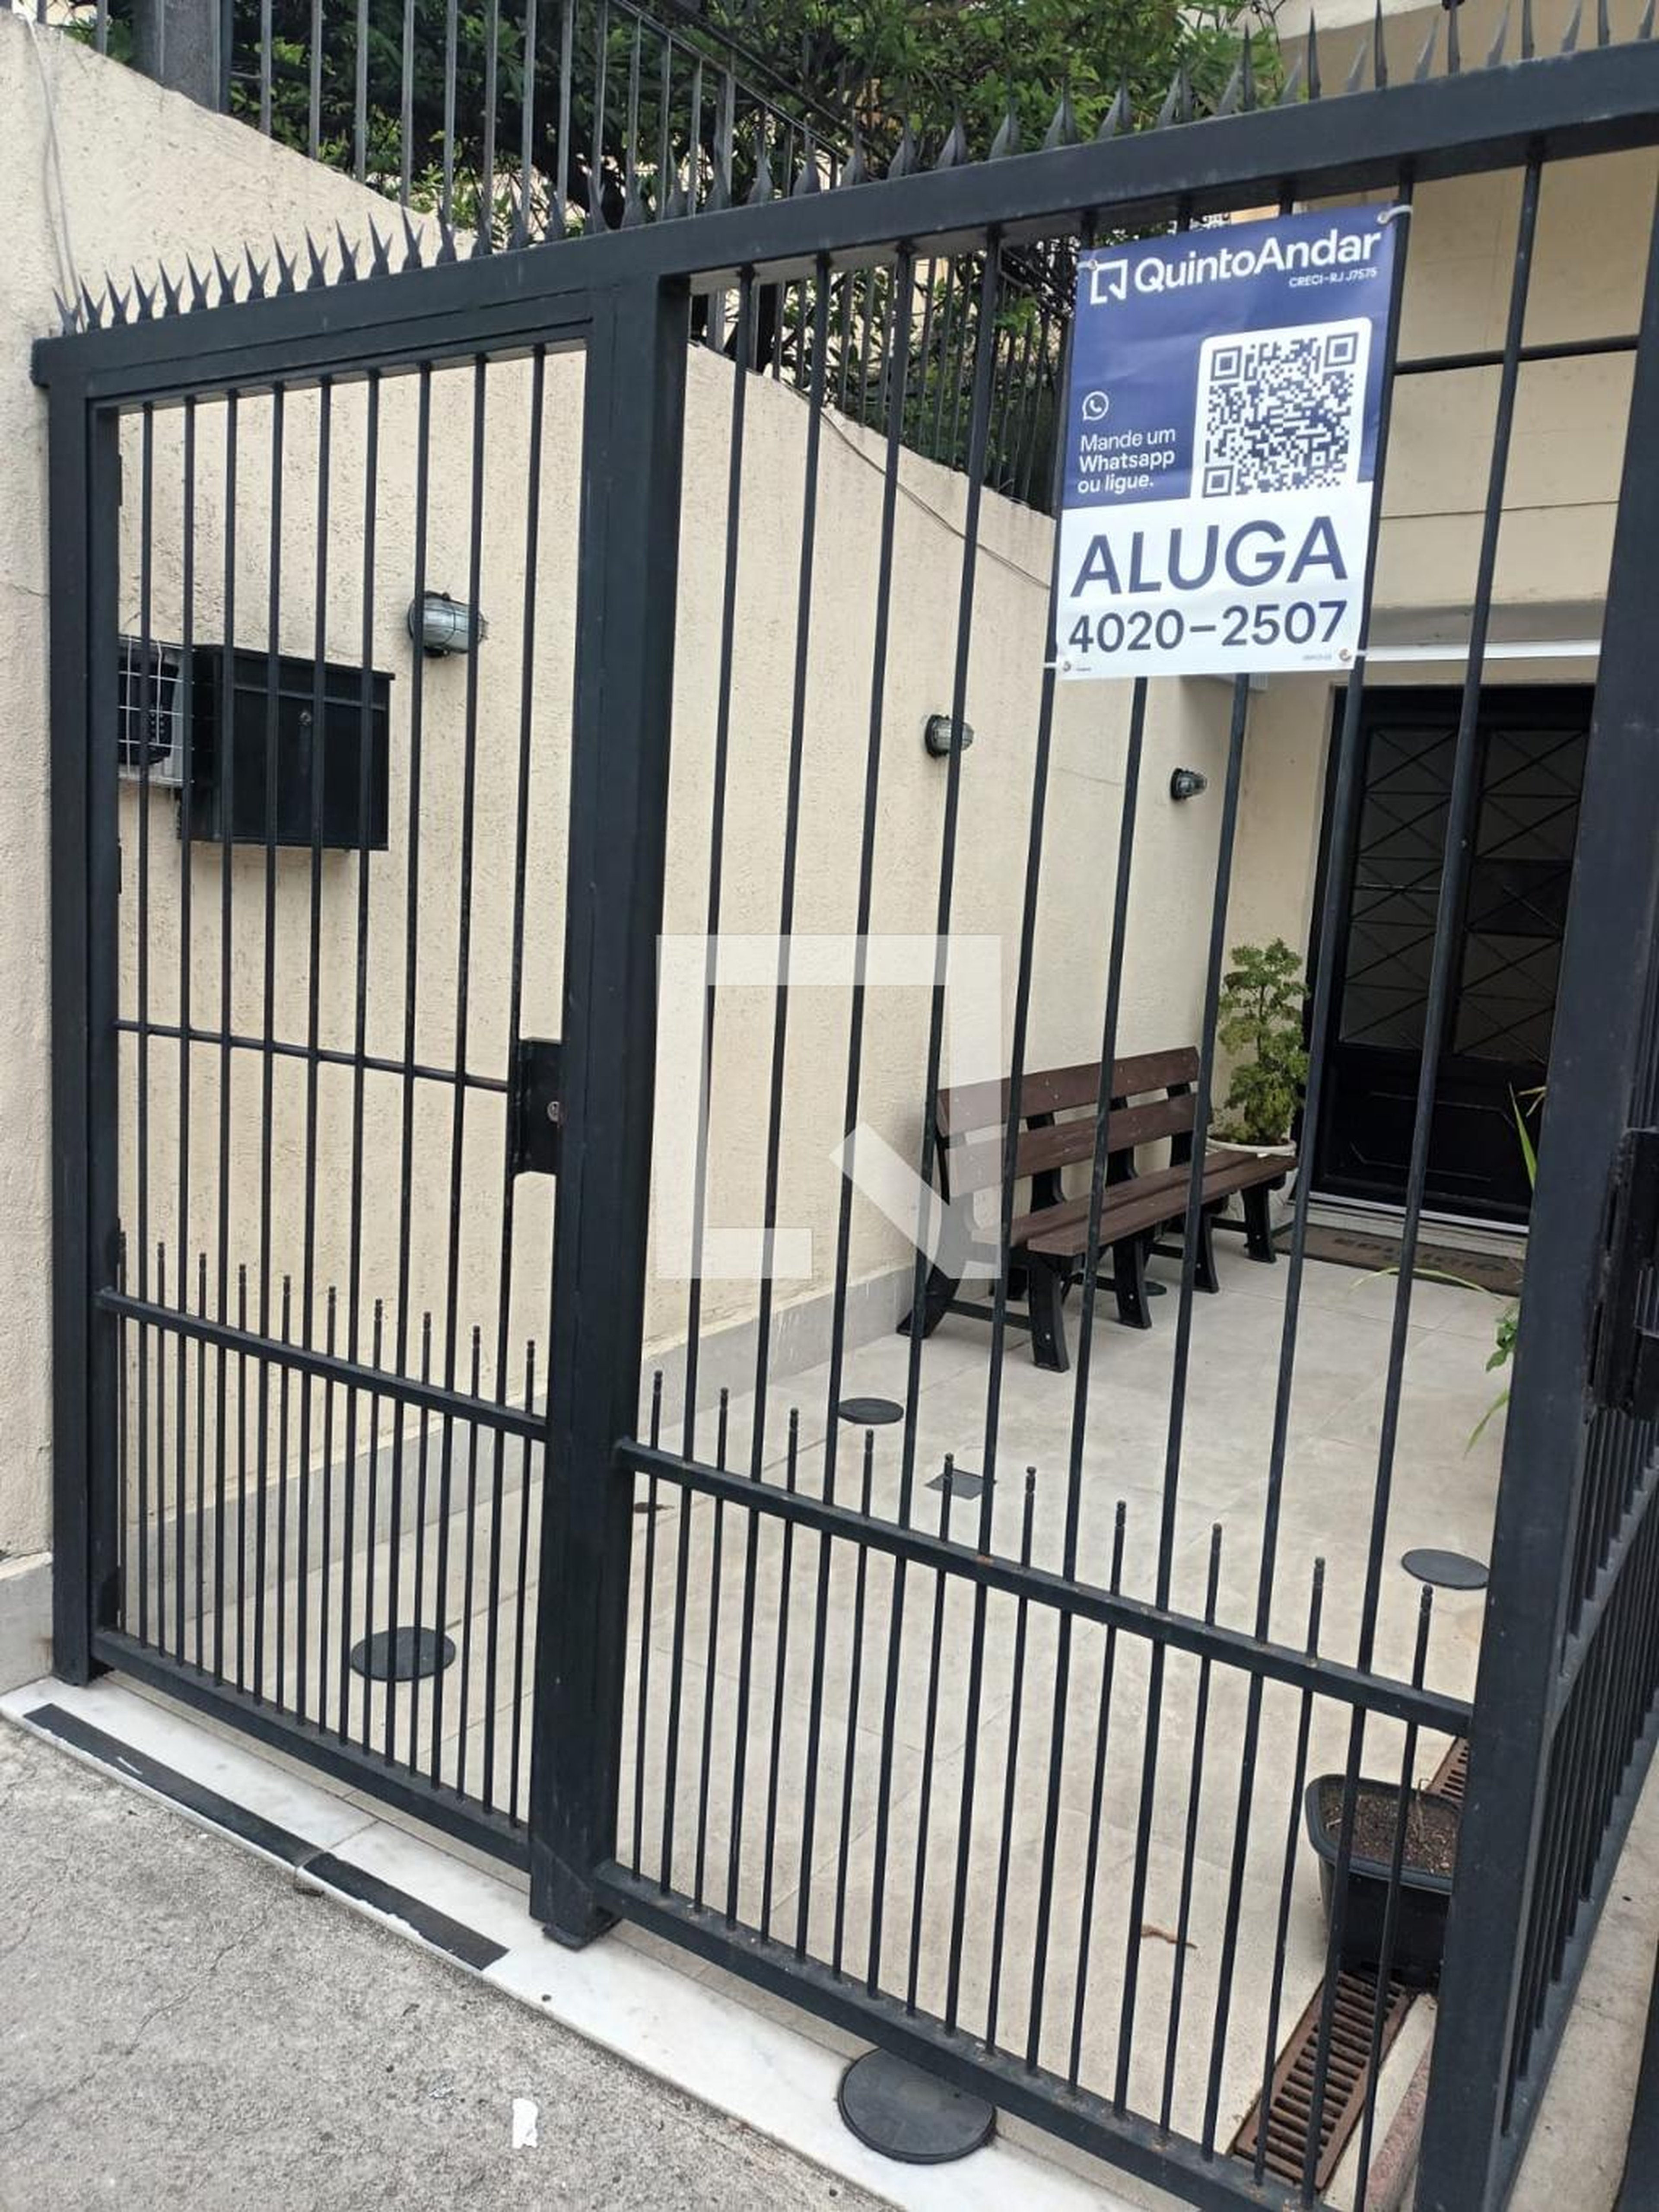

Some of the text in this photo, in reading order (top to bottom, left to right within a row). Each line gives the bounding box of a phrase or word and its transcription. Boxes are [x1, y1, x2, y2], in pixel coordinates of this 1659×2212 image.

[1135, 229, 1381, 293] QuintoAndar
[1289, 272, 1344, 287] CRECI-RJ
[1081, 428, 1176, 452] Mande um
[1079, 450, 1175, 473] Whatsapp
[1077, 473, 1154, 494] ou ligue.
[1070, 516, 1348, 597] ALUGA
[1069, 600, 1348, 653] 4020-2507
